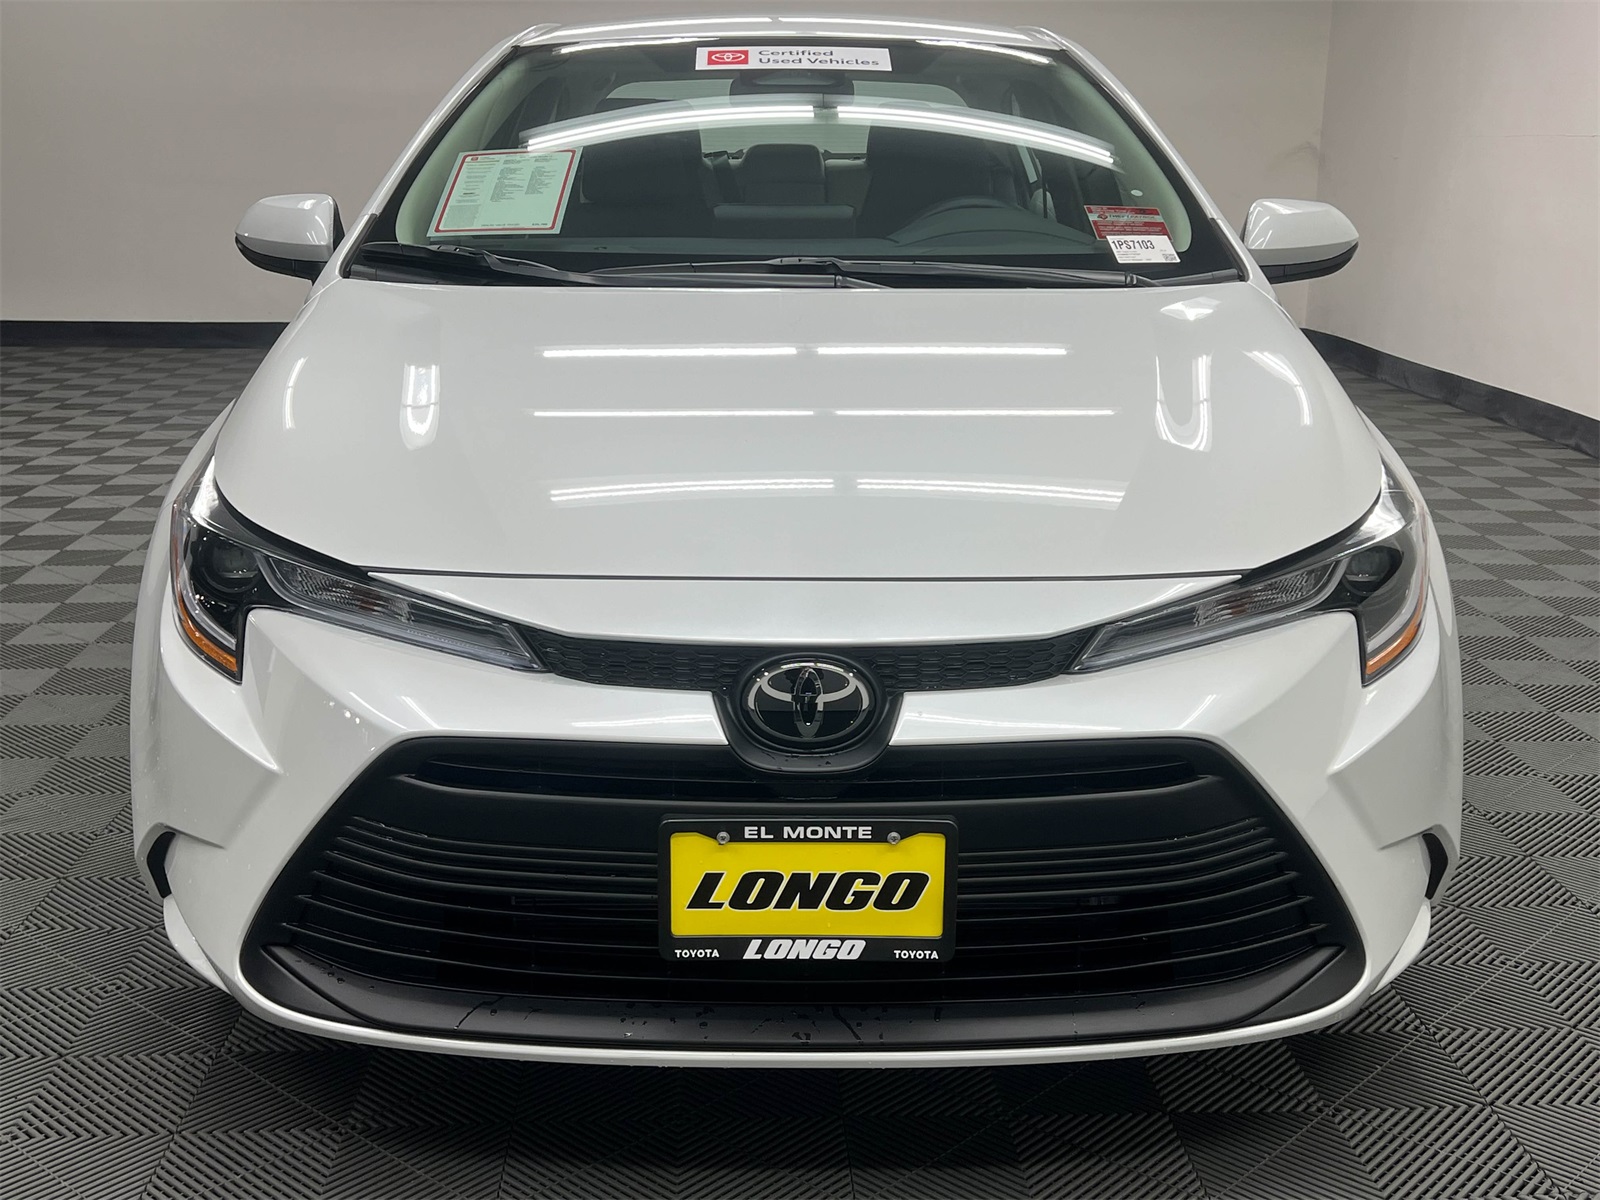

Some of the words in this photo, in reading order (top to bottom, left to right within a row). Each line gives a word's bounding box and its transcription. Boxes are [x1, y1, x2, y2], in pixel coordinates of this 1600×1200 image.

[759, 57, 802, 65] Used
[807, 57, 879, 66] Vehicles
[1112, 240, 1155, 250] 1PS7103
[744, 826, 774, 839] EL
[783, 826, 872, 839] MONTE
[685, 870, 931, 912] LONGO
[674, 949, 720, 958] TOYOTA
[742, 938, 866, 960] LONGO
[893, 949, 939, 959] TOYOTA
